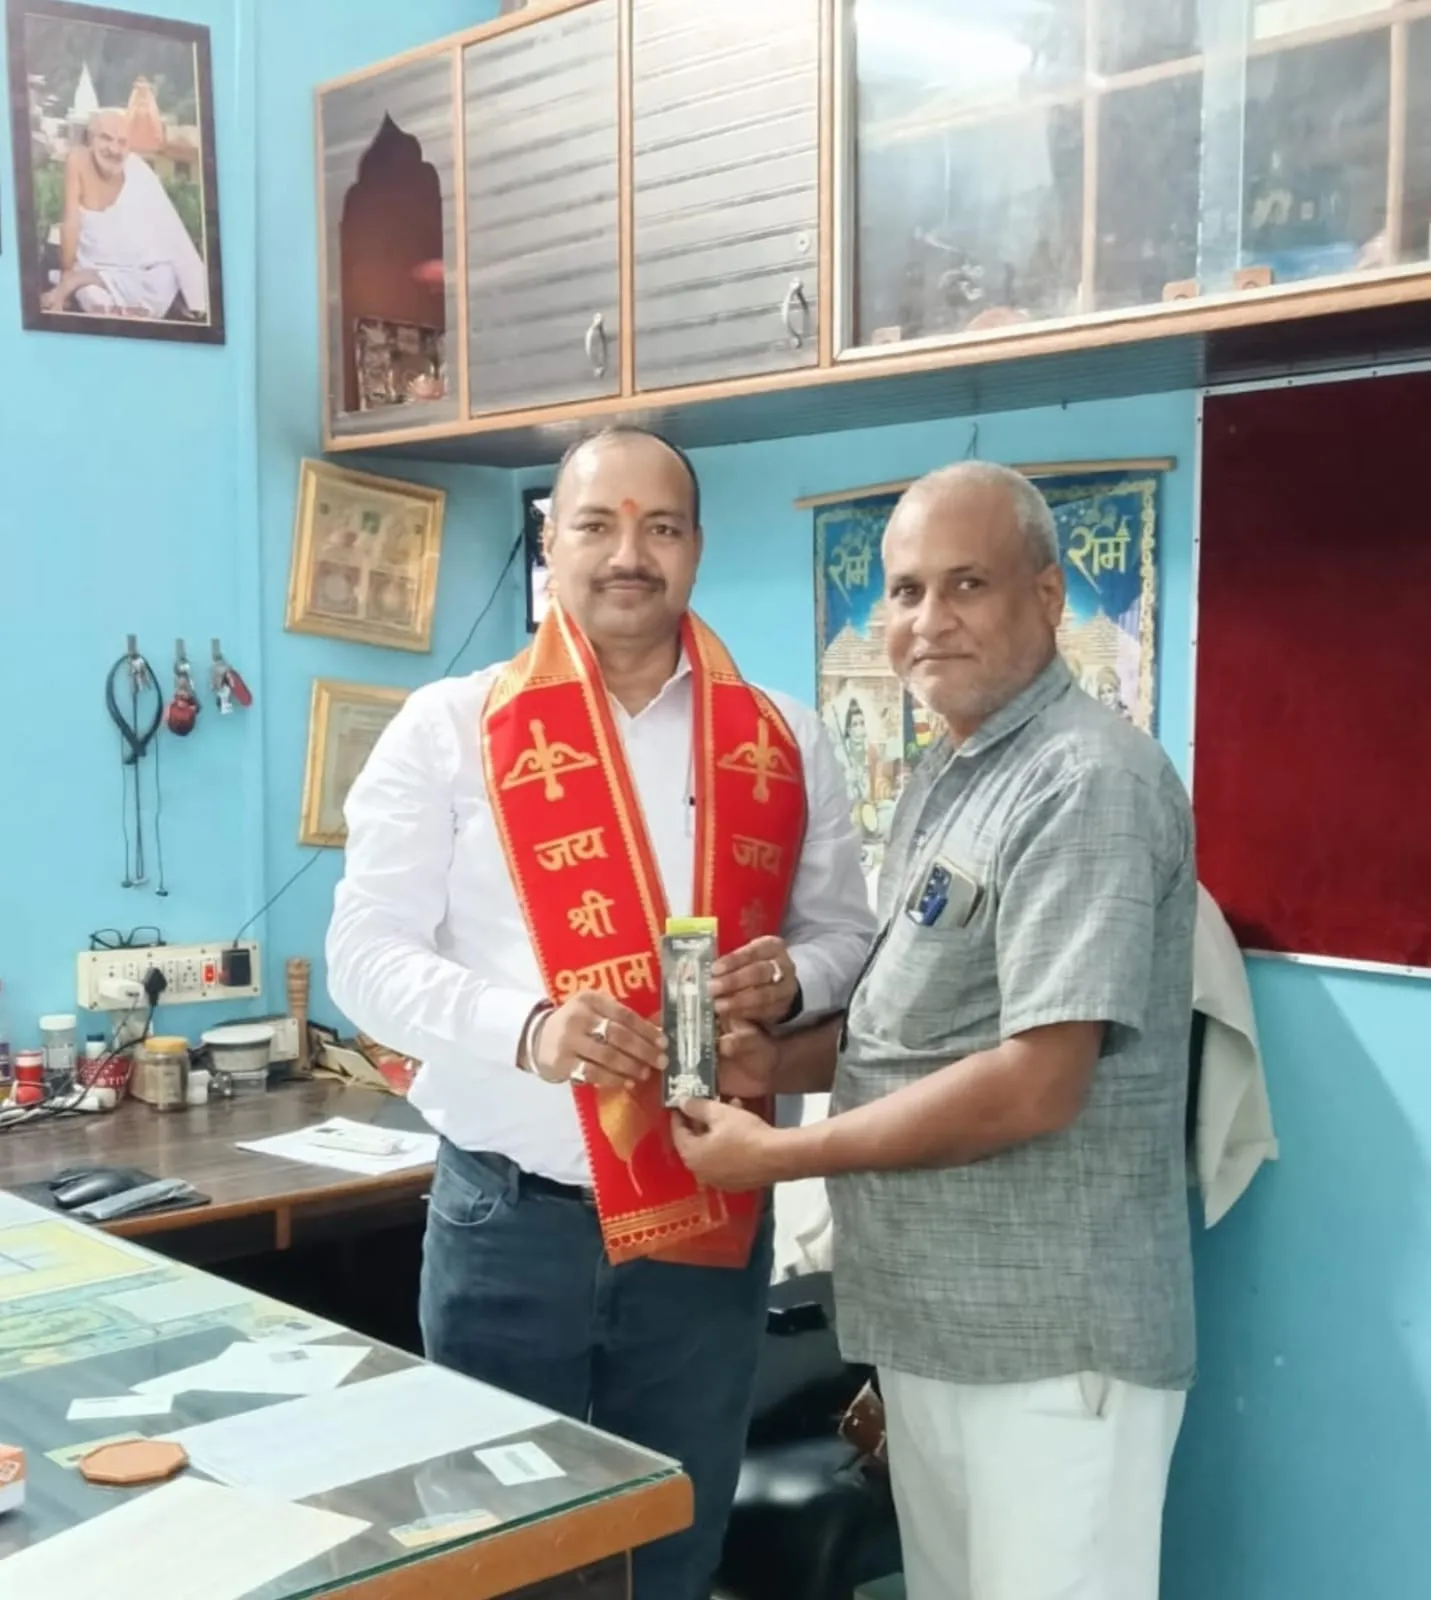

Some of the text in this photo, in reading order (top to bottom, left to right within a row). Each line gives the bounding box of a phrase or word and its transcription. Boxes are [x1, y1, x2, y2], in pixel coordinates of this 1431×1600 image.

[533, 826, 609, 872] जय
[732, 833, 784, 877] जय
[567, 889, 618, 938] श्री
[555, 951, 657, 1002] श्याम
